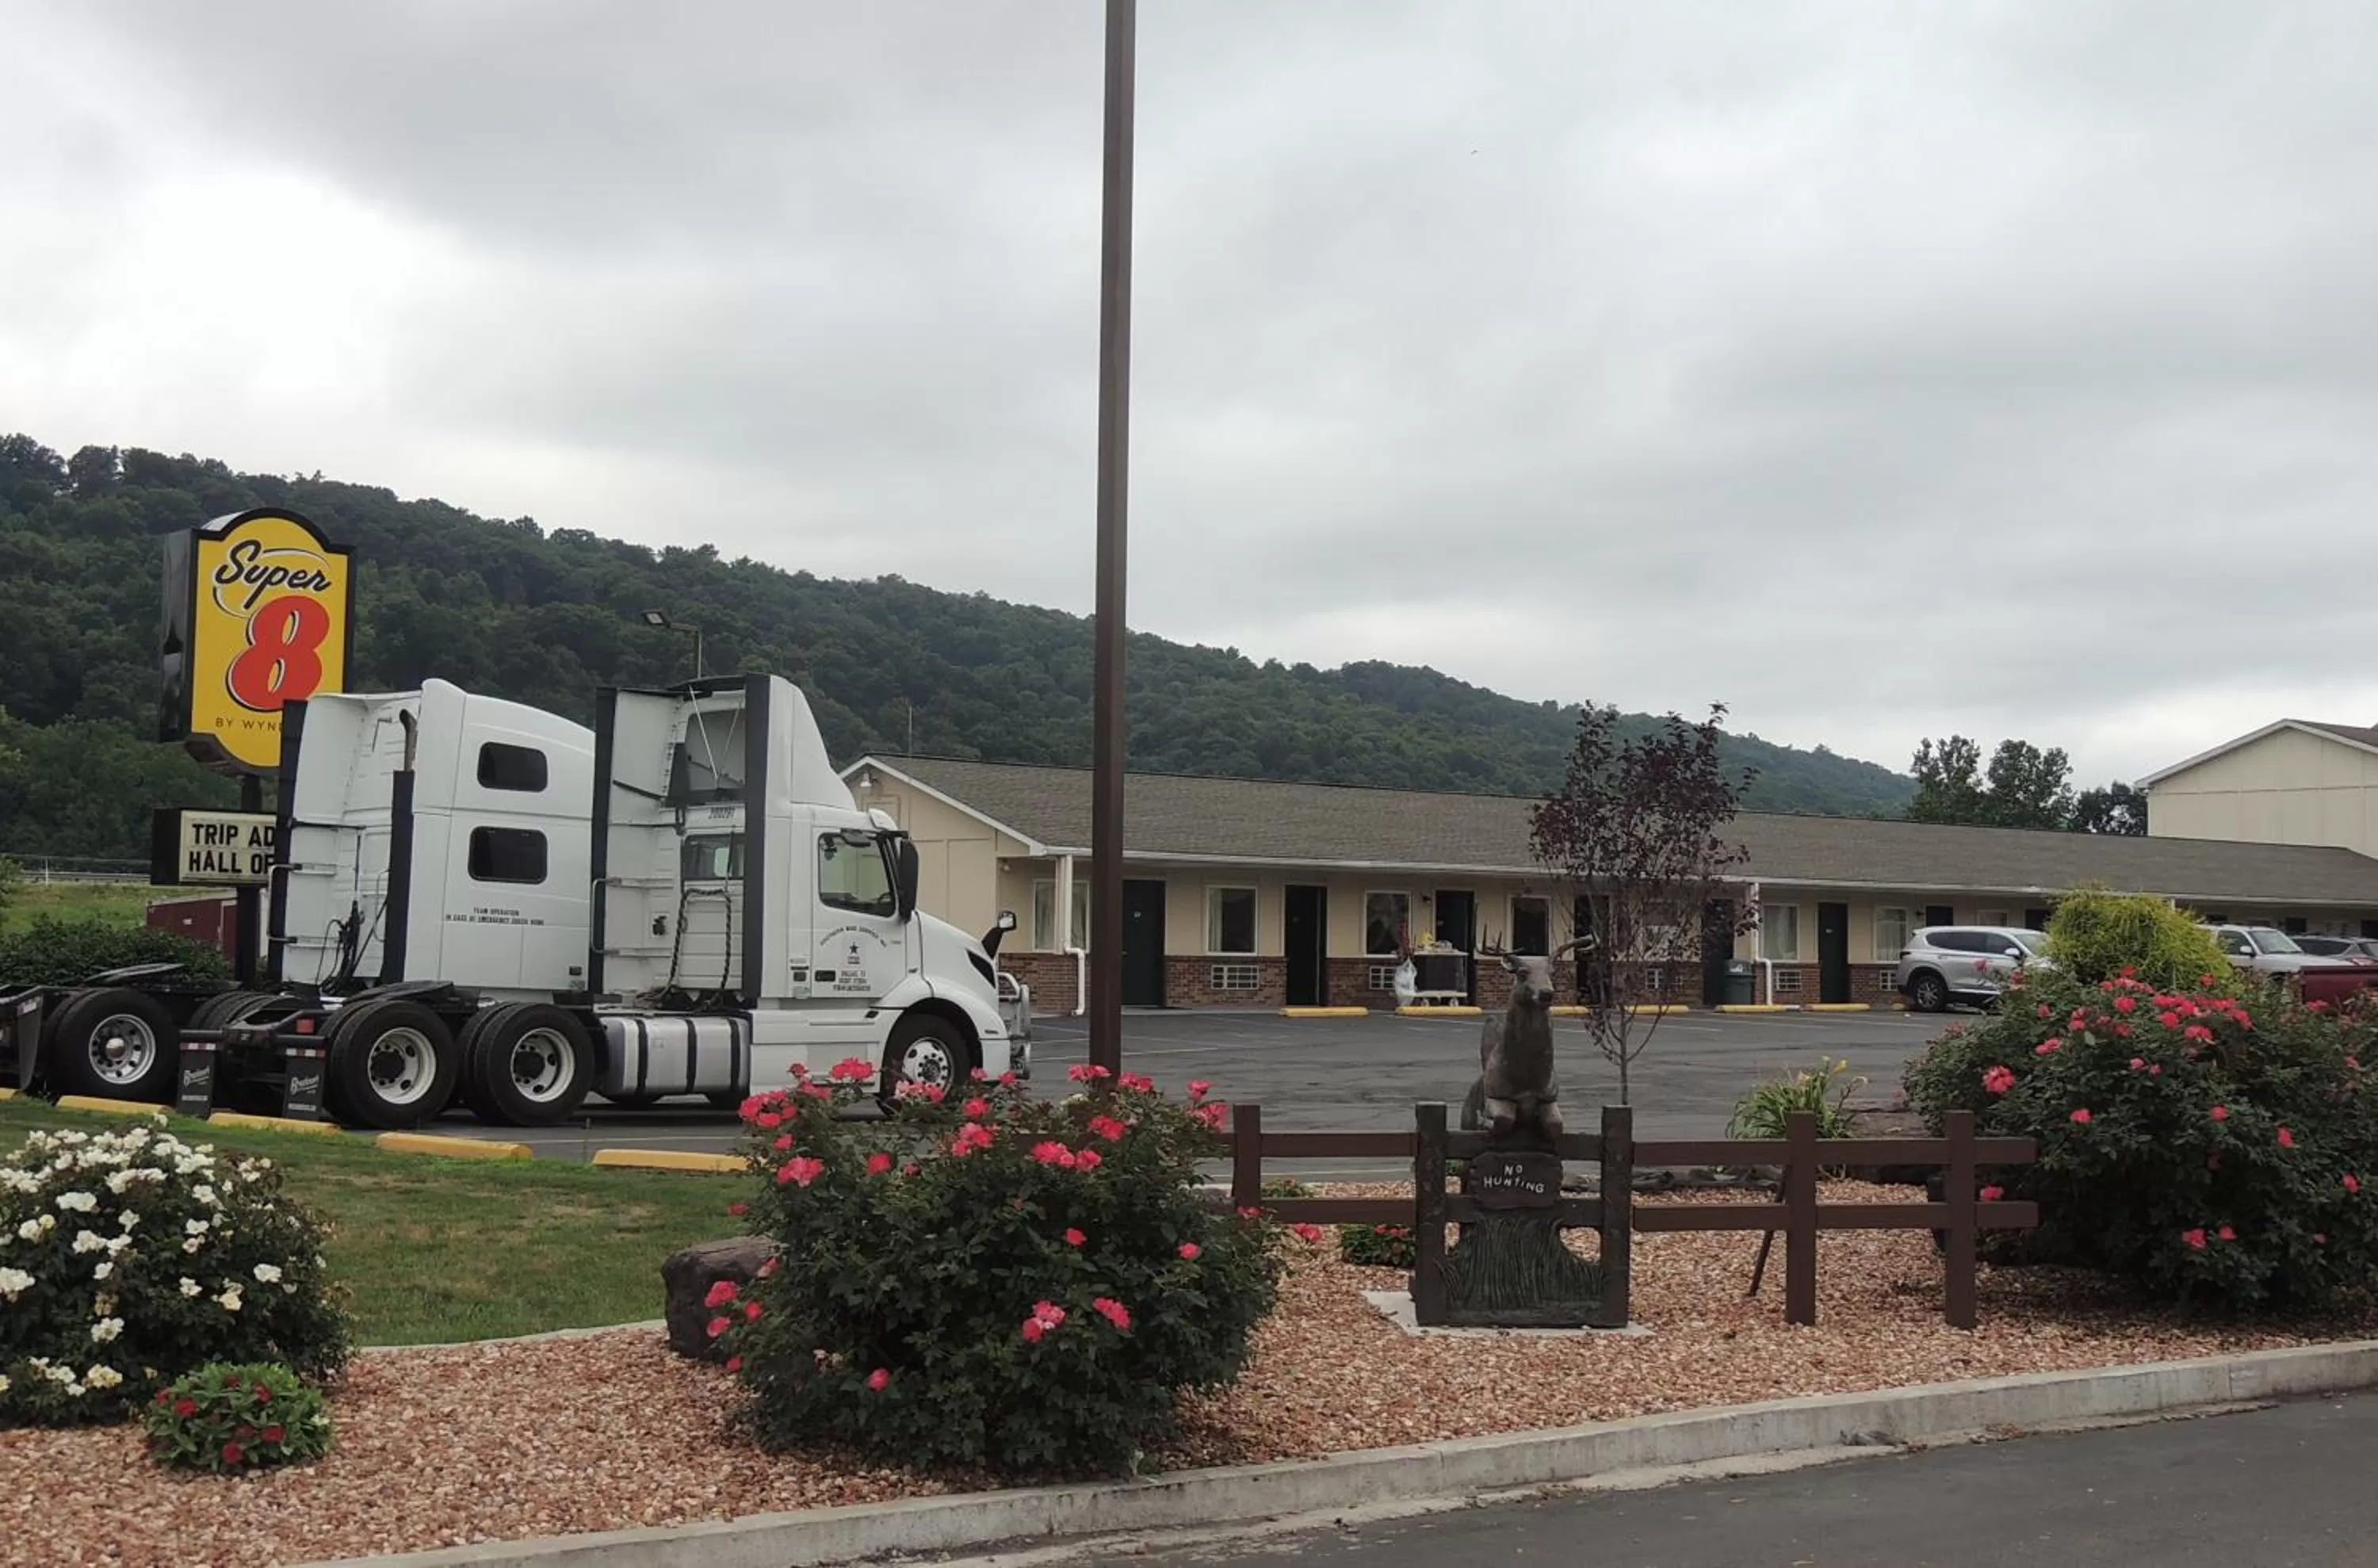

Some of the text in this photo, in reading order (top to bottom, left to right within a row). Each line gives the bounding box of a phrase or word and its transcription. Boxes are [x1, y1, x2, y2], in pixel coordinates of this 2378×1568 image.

[215, 539, 332, 610] Super
[226, 595, 330, 712] 8
[216, 717, 232, 727] BY
[192, 823, 239, 845] TRIP
[189, 850, 242, 873] HALL
[1504, 1165, 1523, 1176] NO
[1483, 1176, 1544, 1193] HUNTING
